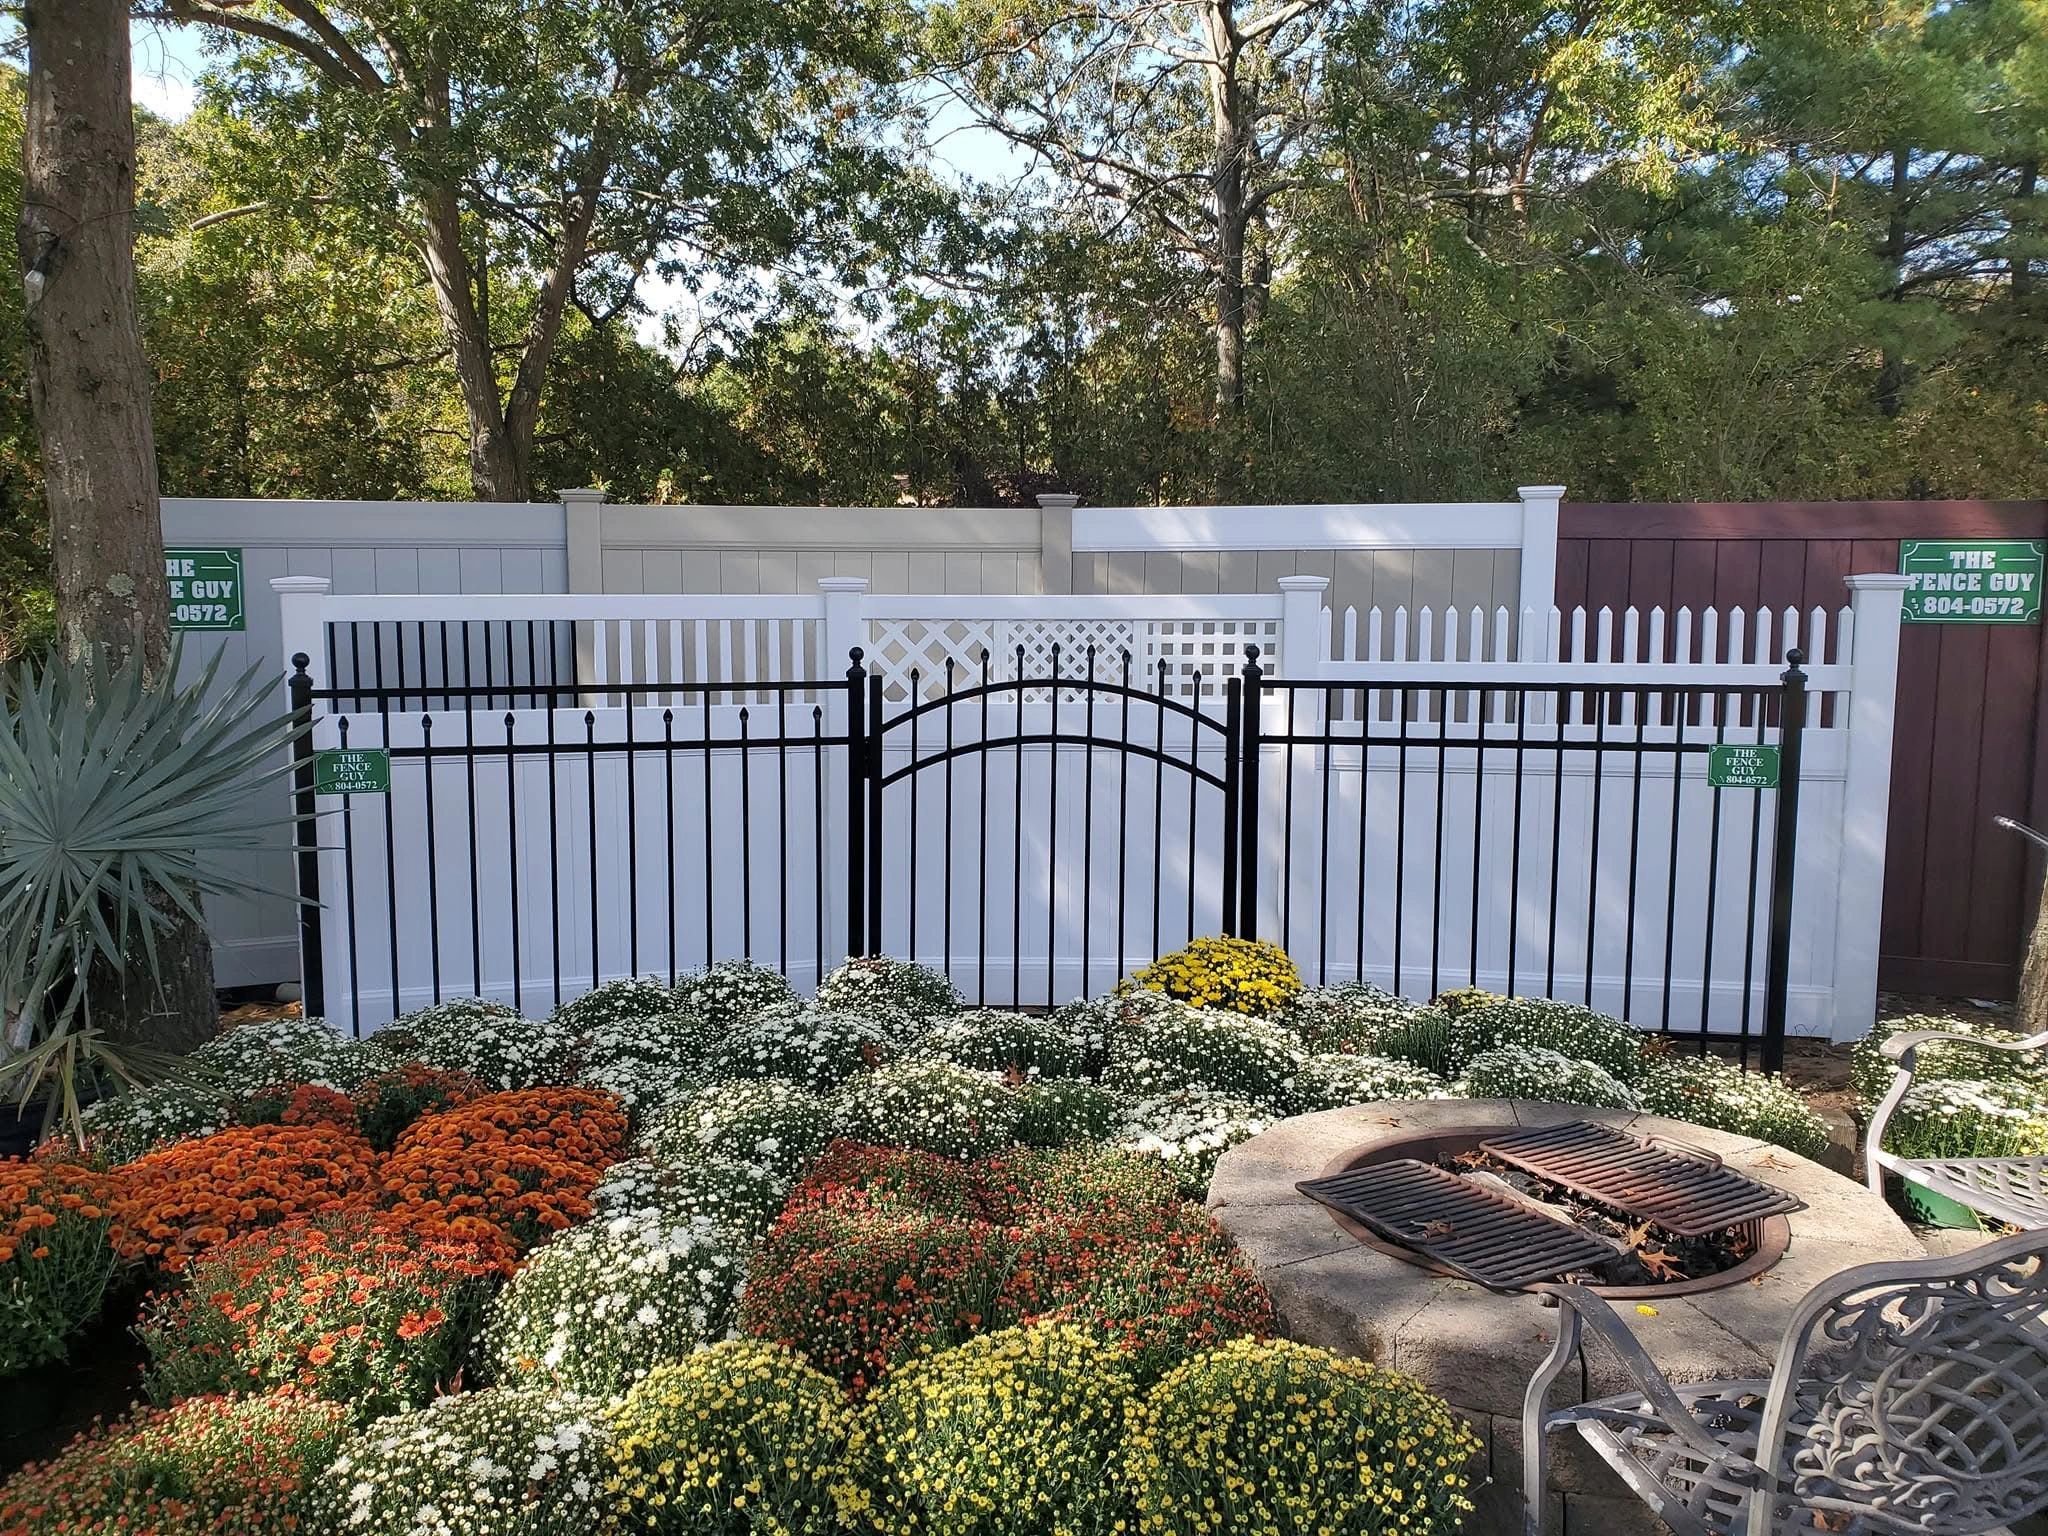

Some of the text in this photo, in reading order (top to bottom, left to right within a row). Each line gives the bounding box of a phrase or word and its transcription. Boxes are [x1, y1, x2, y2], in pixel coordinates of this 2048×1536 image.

[1949, 551, 1997, 569] THE
[165, 559, 195, 577] HE
[1908, 573, 2035, 591] FENCE GUY
[191, 581, 233, 599] GUY
[1923, 597, 2025, 615] 804-0572
[169, 604, 227, 622] -0572
[339, 754, 365, 763] THE
[1733, 749, 1758, 758] THE
[333, 762, 372, 772] FENCE
[1725, 757, 1764, 767] FENCE
[1731, 766, 1757, 775] GUY
[340, 771, 365, 781] GUY
[1726, 775, 1768, 785] 804-0572
[335, 781, 378, 791] 804-0572
